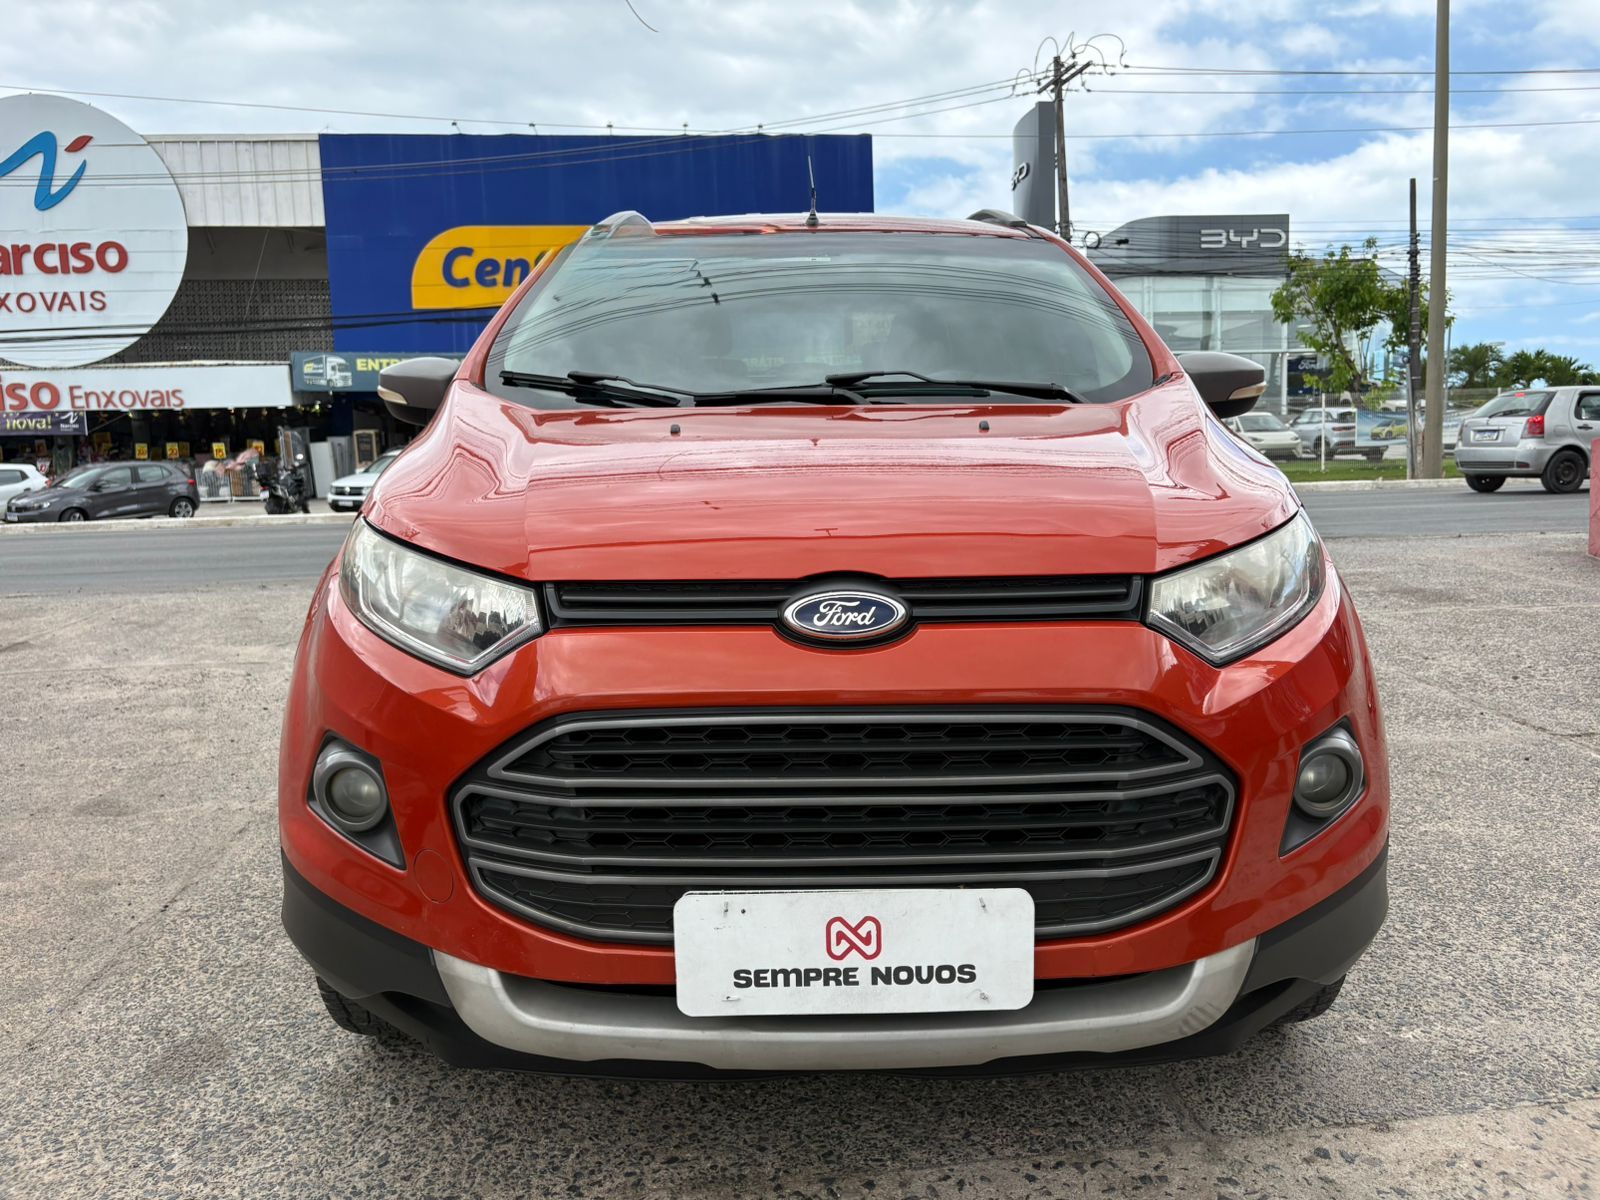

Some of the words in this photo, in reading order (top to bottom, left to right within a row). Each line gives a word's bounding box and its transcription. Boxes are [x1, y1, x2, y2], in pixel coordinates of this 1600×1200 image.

[1200, 228, 1286, 248] BYD
[69, 385, 186, 409] Enxovais
[6, 415, 52, 430] nova!
[813, 600, 876, 626] Ford
[733, 967, 859, 988] SEMPRE
[871, 964, 977, 986] NOVOS
